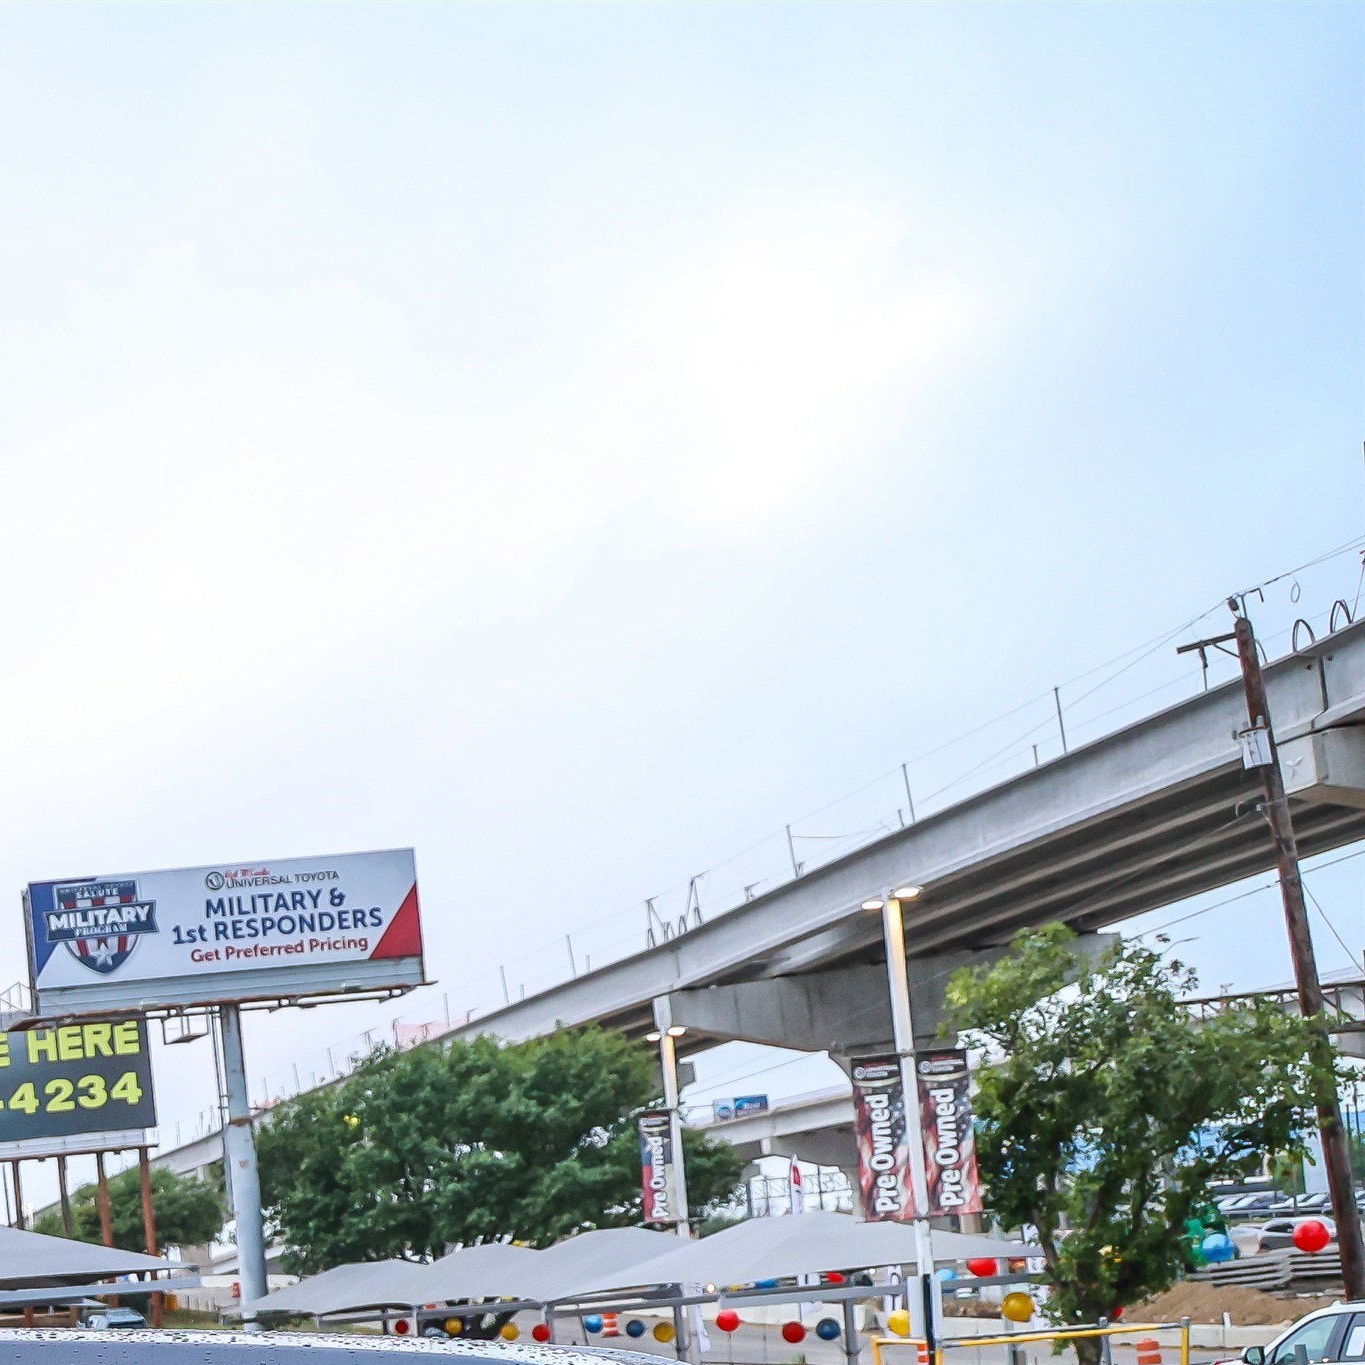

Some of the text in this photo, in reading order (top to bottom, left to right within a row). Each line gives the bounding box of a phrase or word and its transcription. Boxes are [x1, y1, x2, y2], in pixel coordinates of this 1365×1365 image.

[76, 887, 120, 899] SALUTE
[225, 870, 341, 889] UNIVERSAL TOYOTA
[49, 904, 151, 931] MILITARY
[205, 886, 346, 918] MILITARY &
[172, 906, 384, 945] 1st RESPONDERS
[190, 935, 369, 963] Get Preferred Pricing
[26, 1019, 142, 1064] HERE
[864, 1093, 896, 1172] Owned
[929, 1087, 960, 1166] Owned
[875, 1174, 901, 1213] Pre
[940, 1169, 965, 1207] Pre
